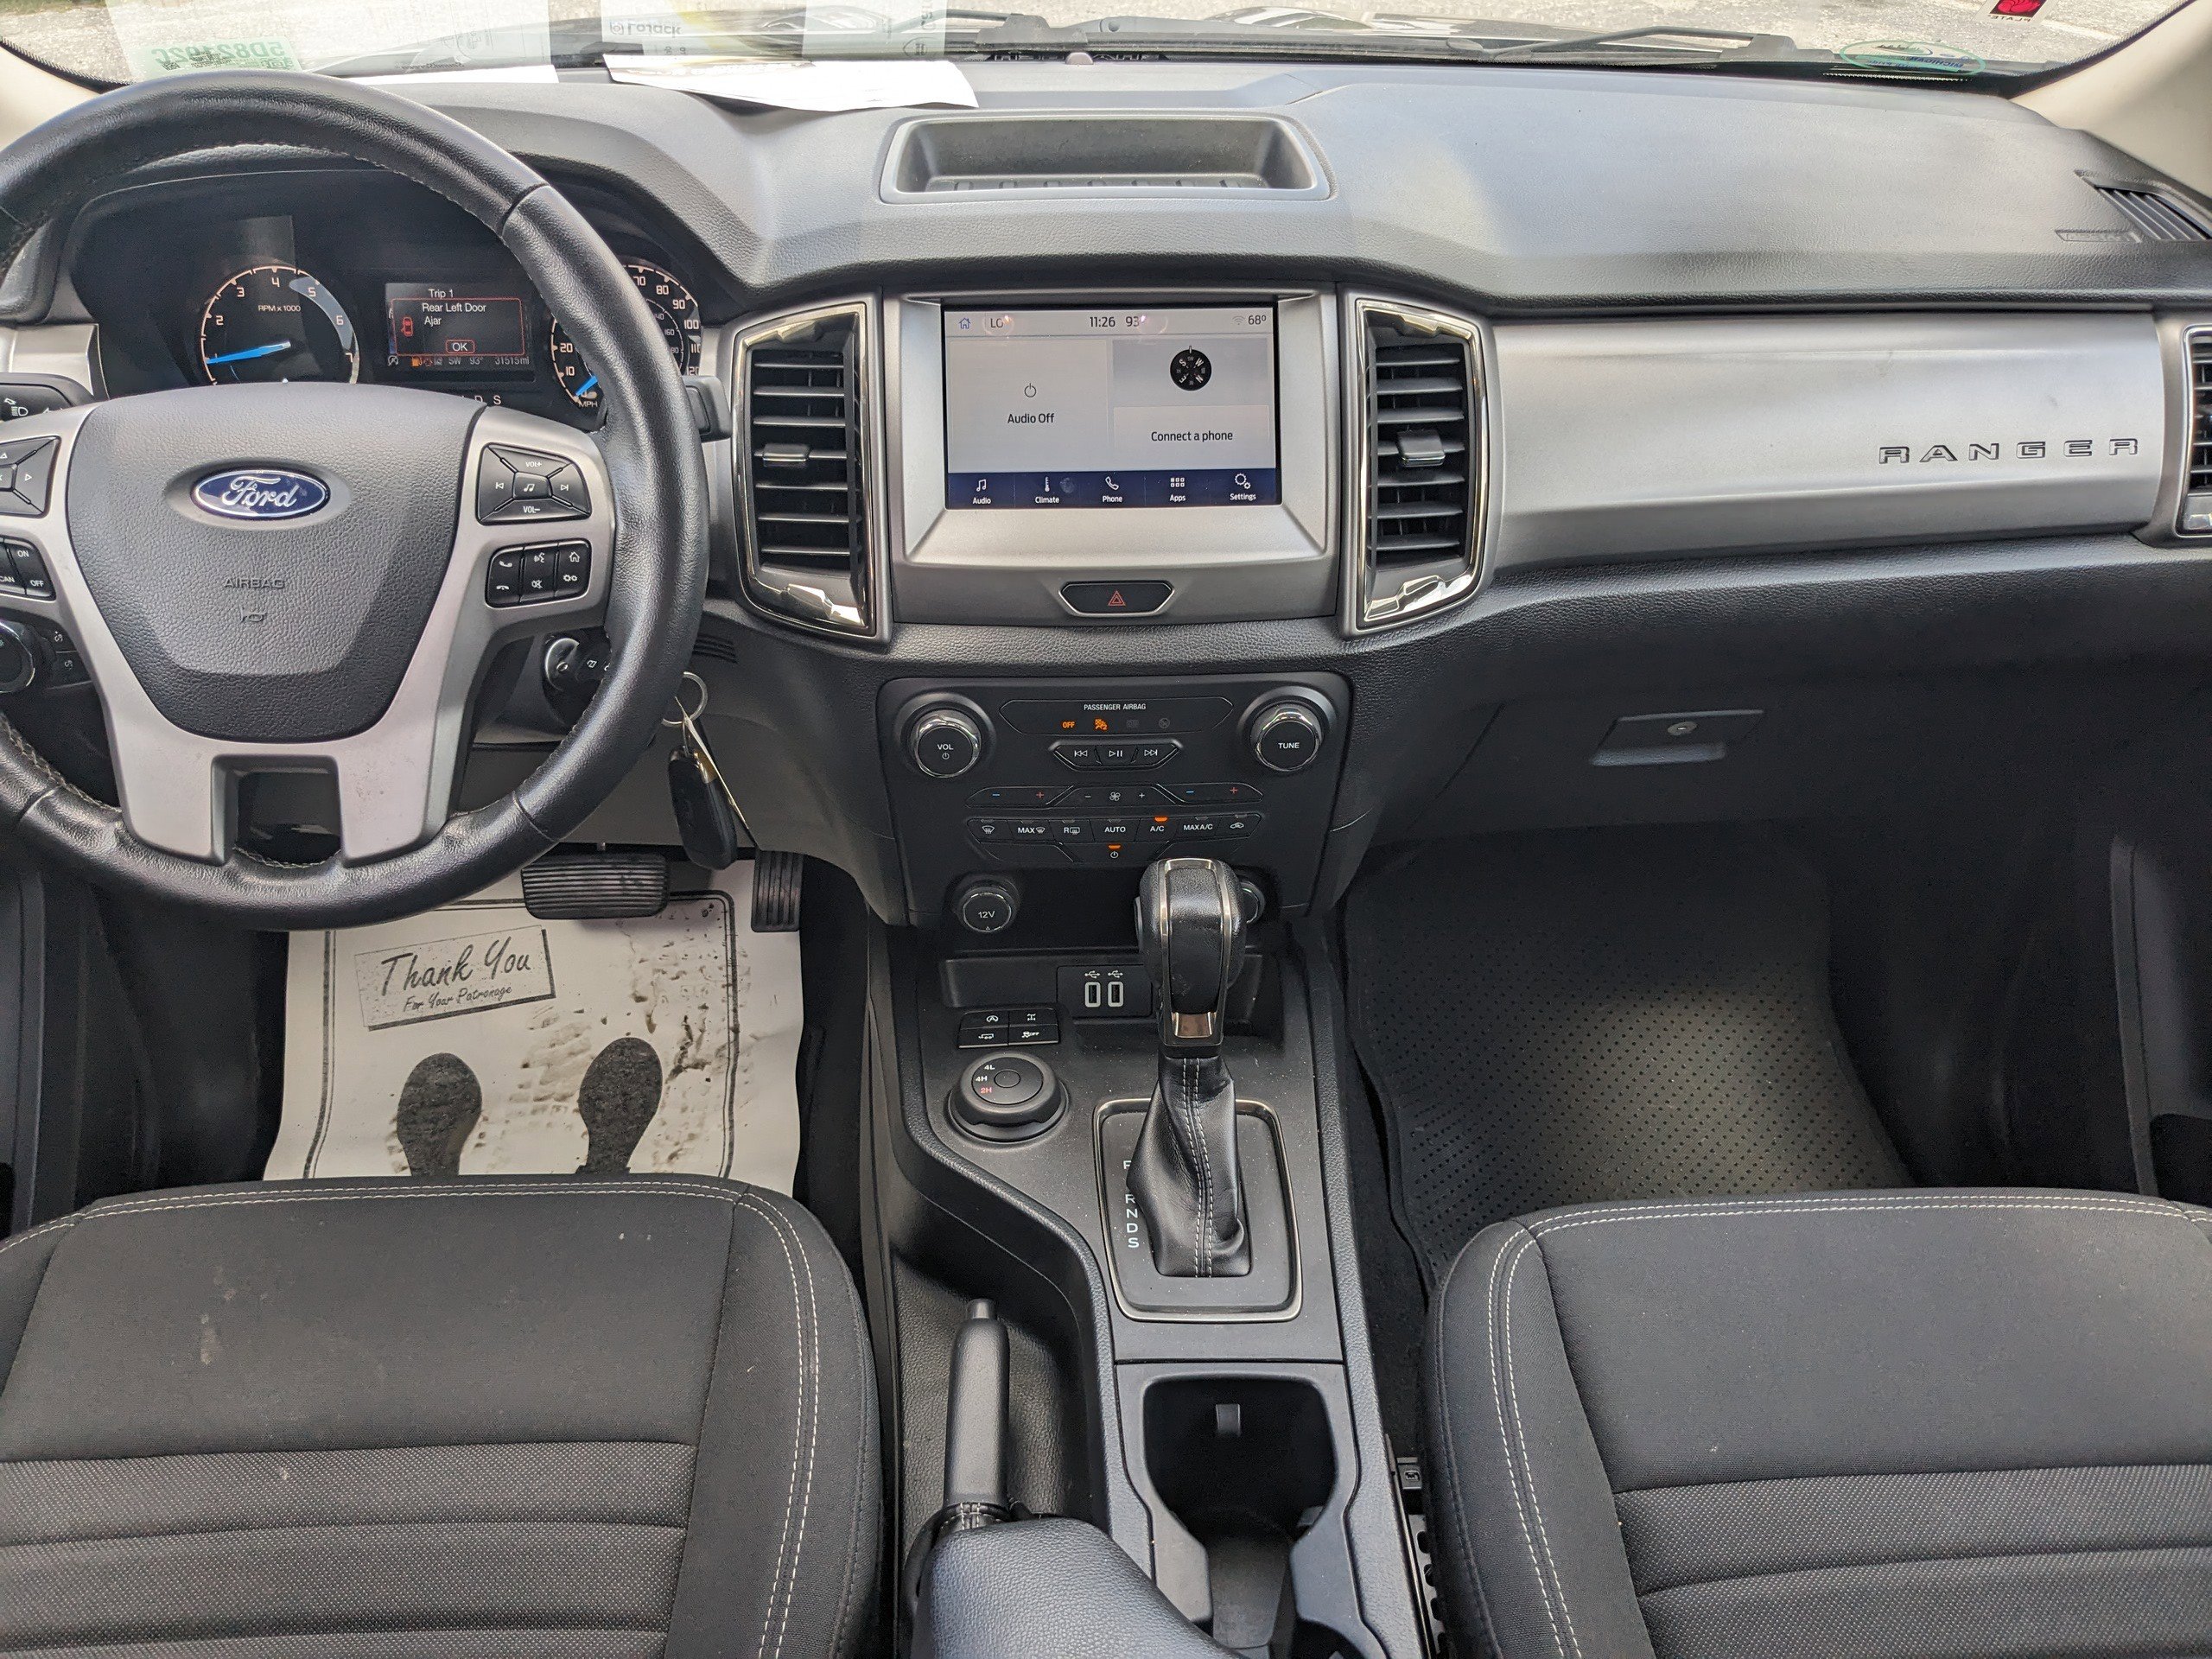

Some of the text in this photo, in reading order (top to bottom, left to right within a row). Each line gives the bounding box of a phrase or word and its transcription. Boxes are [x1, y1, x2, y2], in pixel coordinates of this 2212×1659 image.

[271, 277, 280, 287] 4
[633, 276, 645, 286] 70
[237, 287, 245, 297] 3
[308, 287, 316, 297] 5
[429, 289, 446, 298] Trip
[657, 285, 669, 295] 80
[422, 303, 486, 312] Rear Left Door
[672, 300, 685, 309] 90
[216, 315, 224, 326] 2
[335, 315, 344, 326] 6
[424, 316, 442, 327] Ajar
[684, 320, 699, 329] 100
[1090, 317, 1116, 328] 11:26
[452, 342, 468, 351] OK
[560, 343, 573, 353] 20
[565, 366, 575, 376] 10
[493, 395, 501, 404] S
[1007, 413, 1055, 423] Audio Off
[1151, 431, 1192, 442] Connect
[1202, 430, 1233, 442] phone
[1878, 438, 2139, 464] RANGER
[221, 474, 299, 507] Ford
[1230, 493, 1256, 502] Settings
[224, 578, 286, 588] AIRBAG
[381, 937, 531, 996] Thank You
[404, 985, 512, 1012] For Your Patronage
[1125, 1194, 1135, 1204] R
[1126, 1209, 1138, 1218] N
[1126, 1223, 1138, 1233] D
[1128, 1237, 1140, 1248] S
